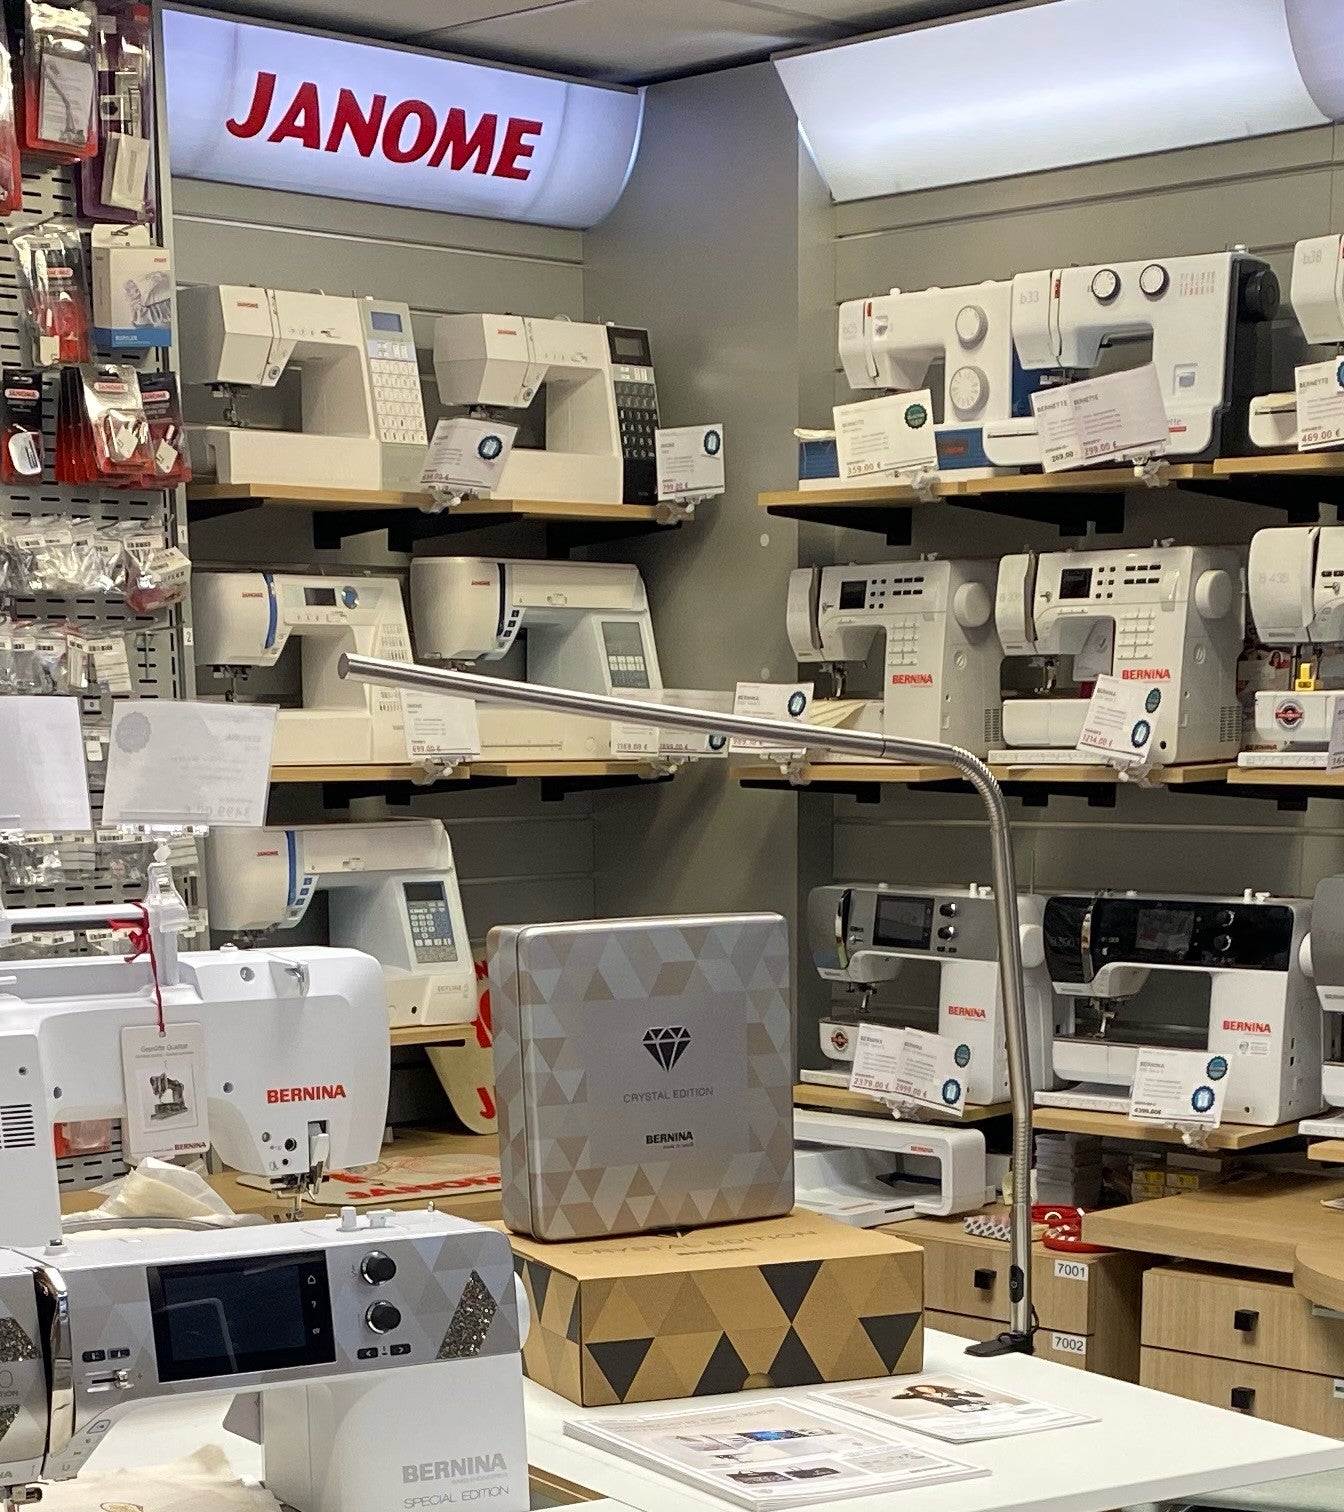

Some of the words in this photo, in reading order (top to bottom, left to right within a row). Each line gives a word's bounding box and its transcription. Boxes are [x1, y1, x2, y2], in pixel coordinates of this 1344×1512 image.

[226, 71, 543, 181] JANOME
[1298, 377, 1329, 389] BERNETTE
[1301, 430, 1333, 443] 469.00
[1335, 429, 1341, 438] €
[1084, 442, 1111, 457] 299.00
[1113, 439, 1119, 450] €
[876, 461, 882, 470] €
[892, 673, 934, 685] BERNINA
[1122, 668, 1172, 681] BERNINA
[948, 1005, 987, 1019] BERNINA
[1222, 1019, 1272, 1034] BERNINA
[265, 1084, 347, 1105] BERNINA
[622, 1091, 671, 1104] CRYSTAL
[672, 1086, 715, 1100] EDITION
[174, 1141, 207, 1151] BERNINA
[645, 1131, 694, 1146] BERNINA
[706, 1230, 818, 1247] EDITION
[1057, 1262, 1085, 1278] 7001
[1054, 1336, 1084, 1352] 7002
[401, 1451, 508, 1484] BERNINA
[403, 1489, 459, 1510] SPECIAL
[462, 1484, 509, 1505] EDITION
